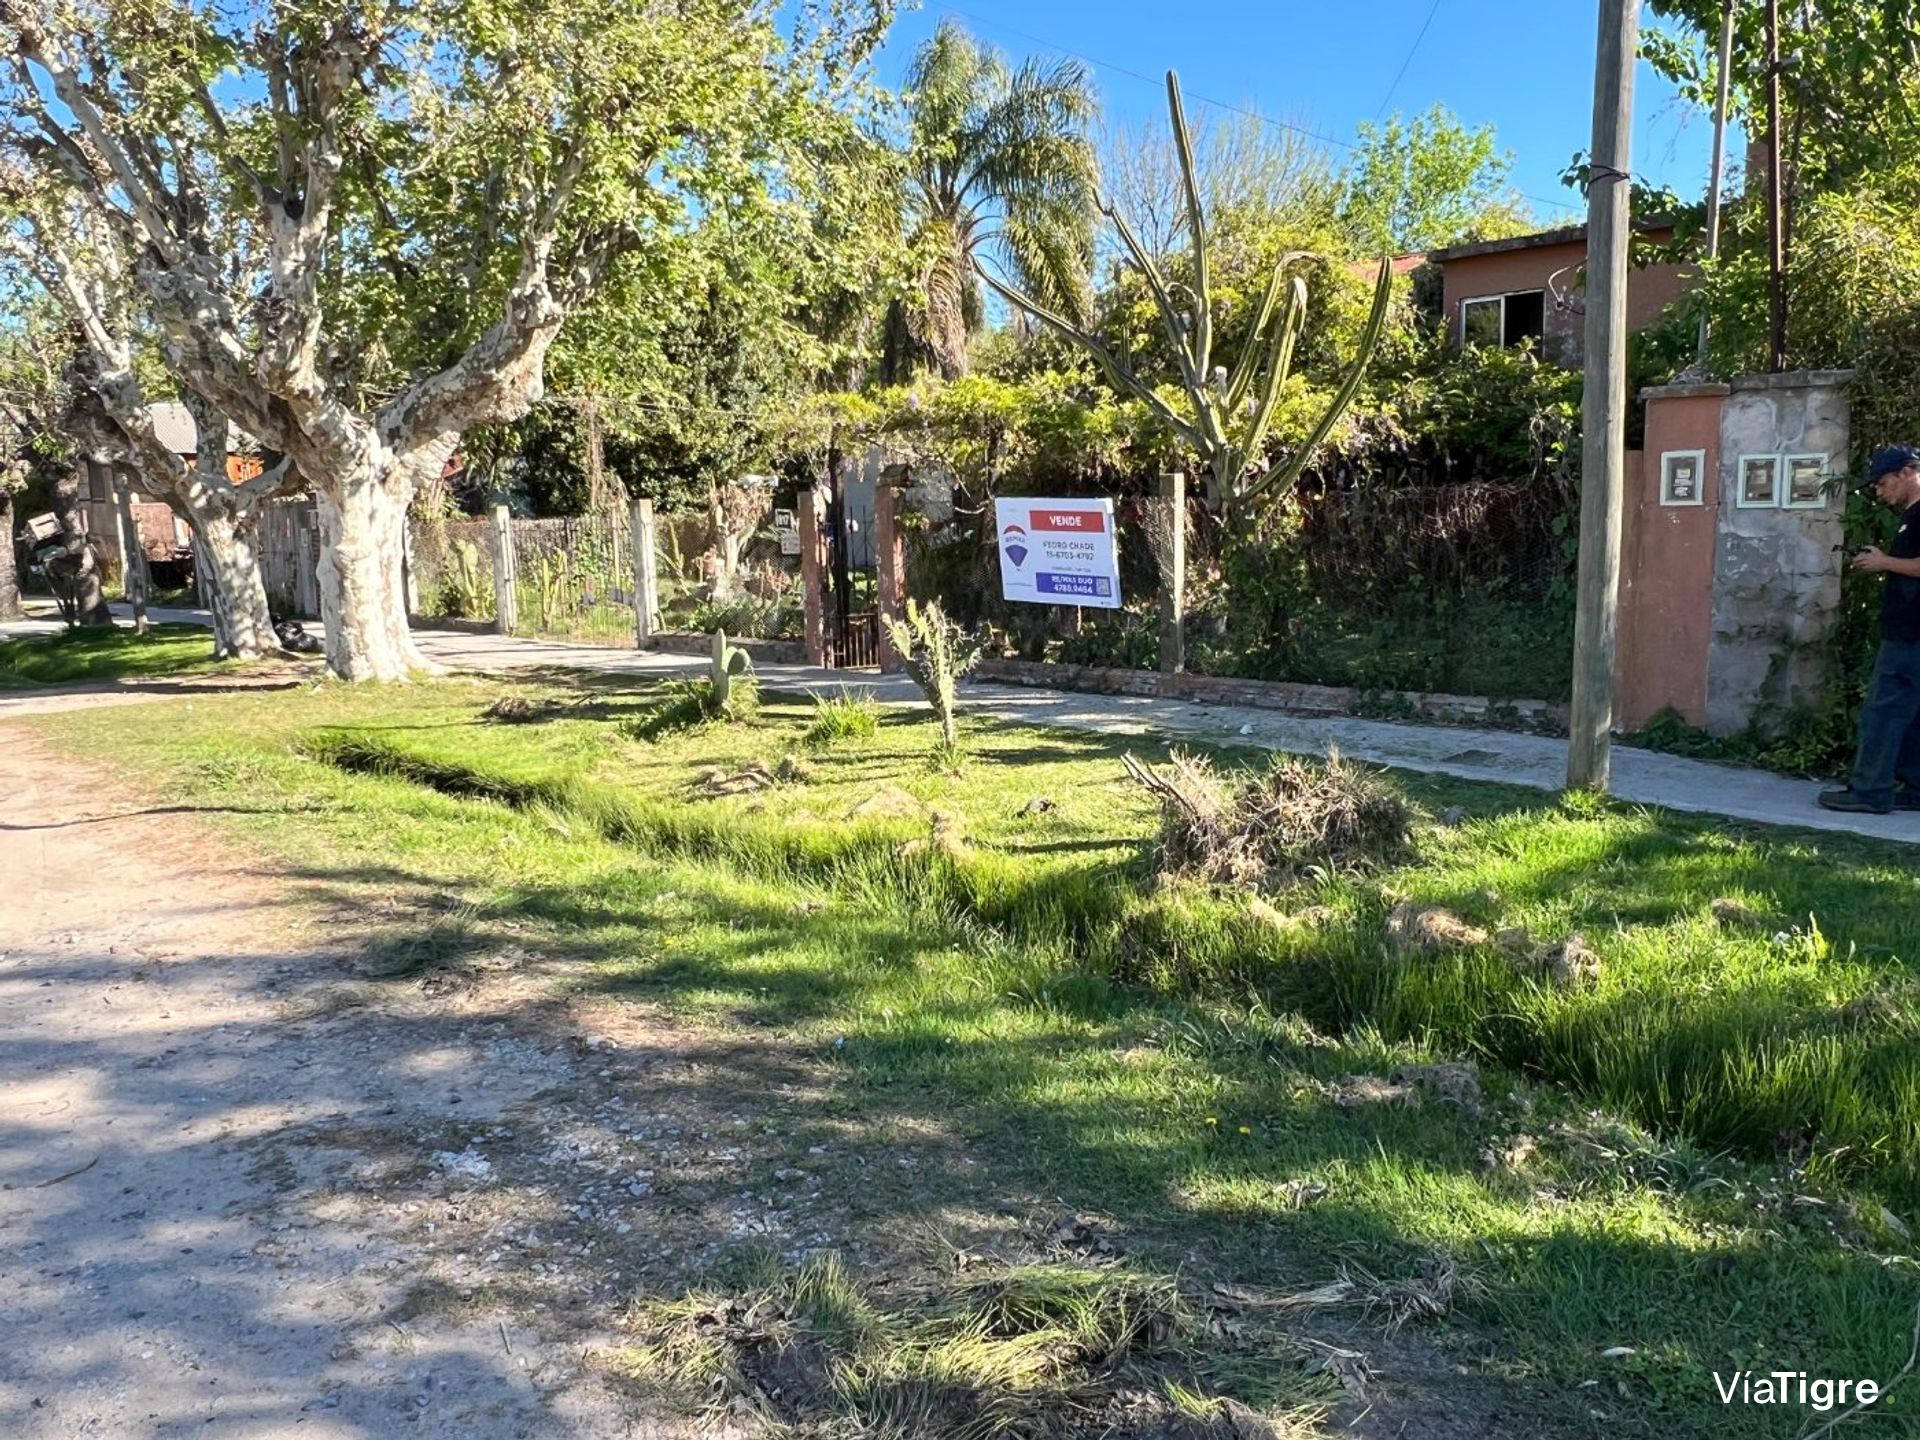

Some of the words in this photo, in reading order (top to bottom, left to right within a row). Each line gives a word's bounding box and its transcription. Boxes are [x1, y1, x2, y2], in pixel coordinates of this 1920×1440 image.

[1049, 515, 1082, 527] VENDE
[1069, 541, 1095, 551] CHADE
[1078, 577, 1093, 585] DUO
